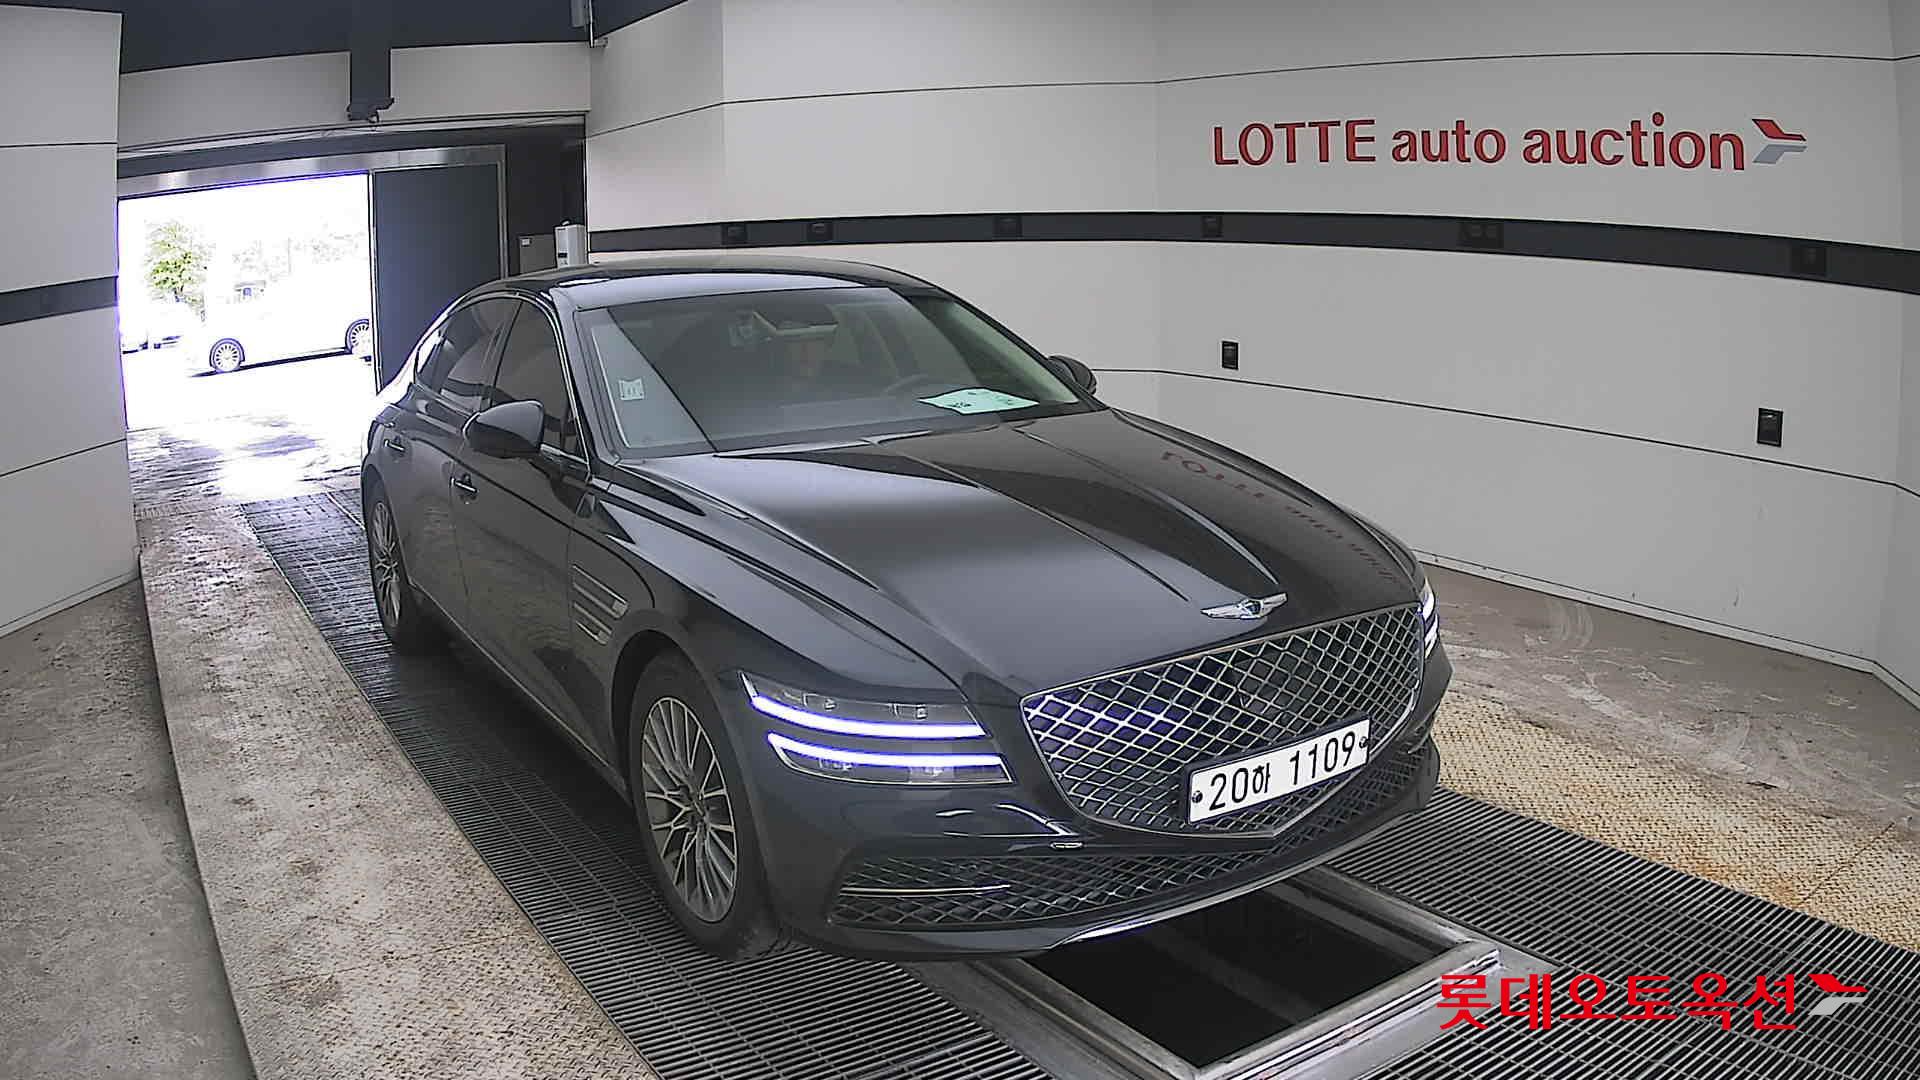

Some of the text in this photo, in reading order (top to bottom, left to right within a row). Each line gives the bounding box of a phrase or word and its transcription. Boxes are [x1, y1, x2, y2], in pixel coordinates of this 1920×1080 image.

[1213, 112, 1745, 171] LOTTE auto auction
[1209, 731, 1356, 811] 20하 1109
